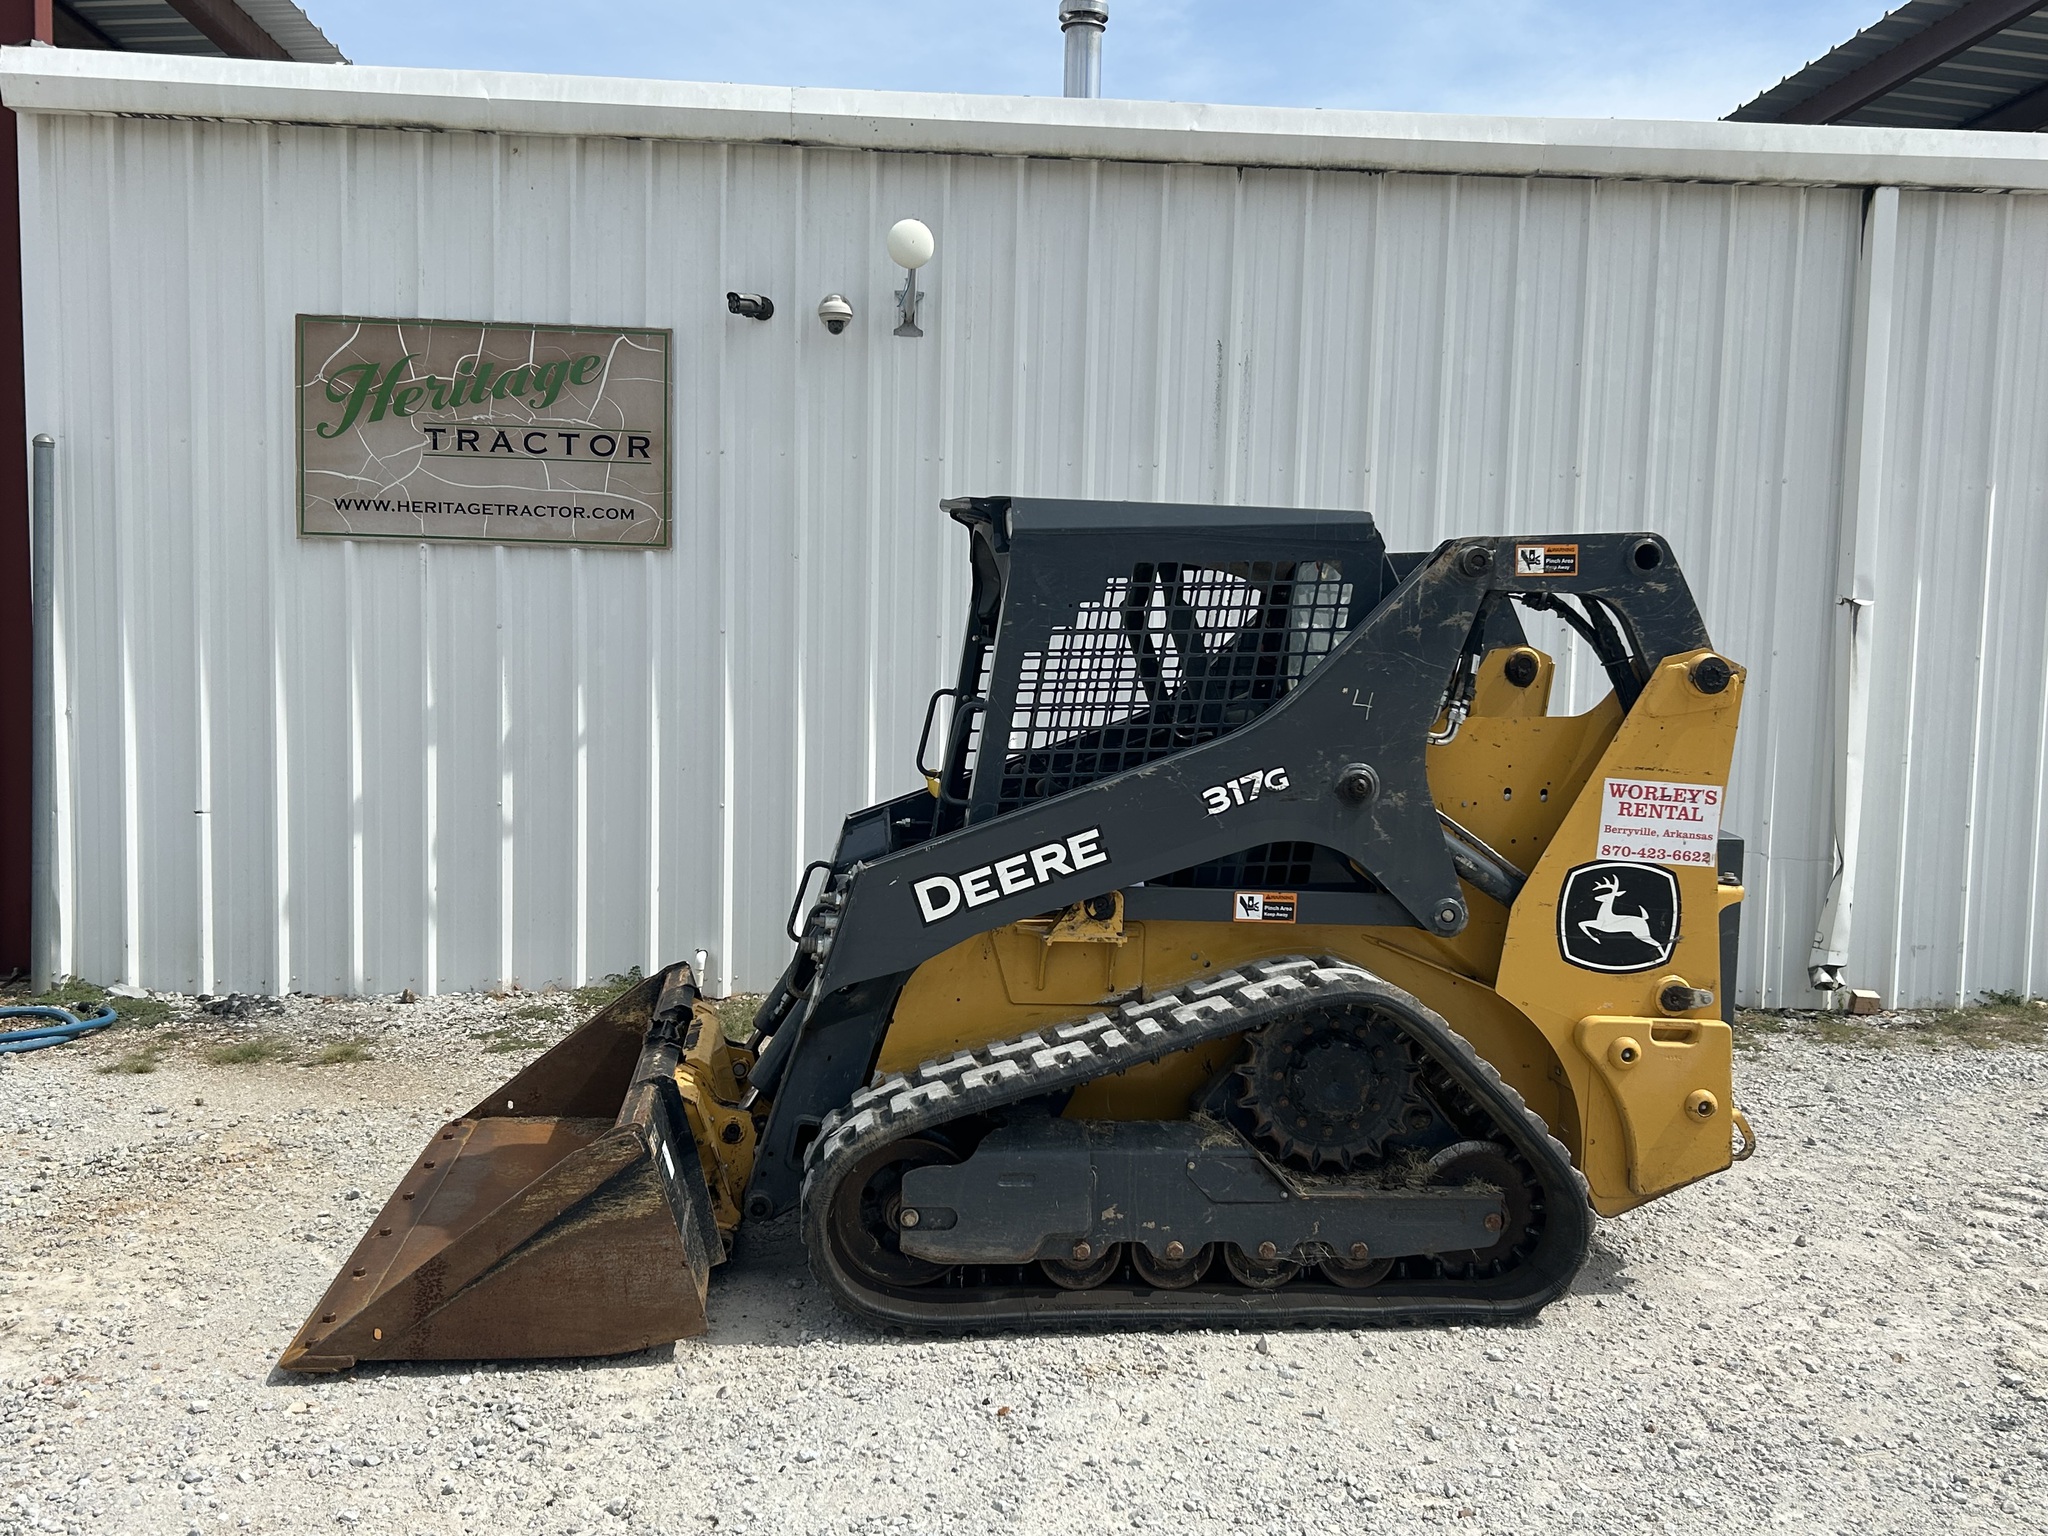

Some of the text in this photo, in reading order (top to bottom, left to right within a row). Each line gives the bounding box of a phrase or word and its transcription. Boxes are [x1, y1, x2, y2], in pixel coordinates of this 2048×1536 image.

[316, 353, 605, 438] Heritage
[423, 427, 652, 459] TRACTOR
[333, 498, 635, 520] WWW.HERITAGETRACTOR.COM
[1352, 688, 1374, 720] 4
[1202, 767, 1290, 815] 317G
[1609, 783, 1717, 806] WORLEY'S
[1617, 801, 1704, 822] RENTAL
[1604, 825, 1713, 841] Berryville, Arkansas
[1601, 845, 1711, 863] 870-423-6622
[913, 828, 1108, 923] DEERE
